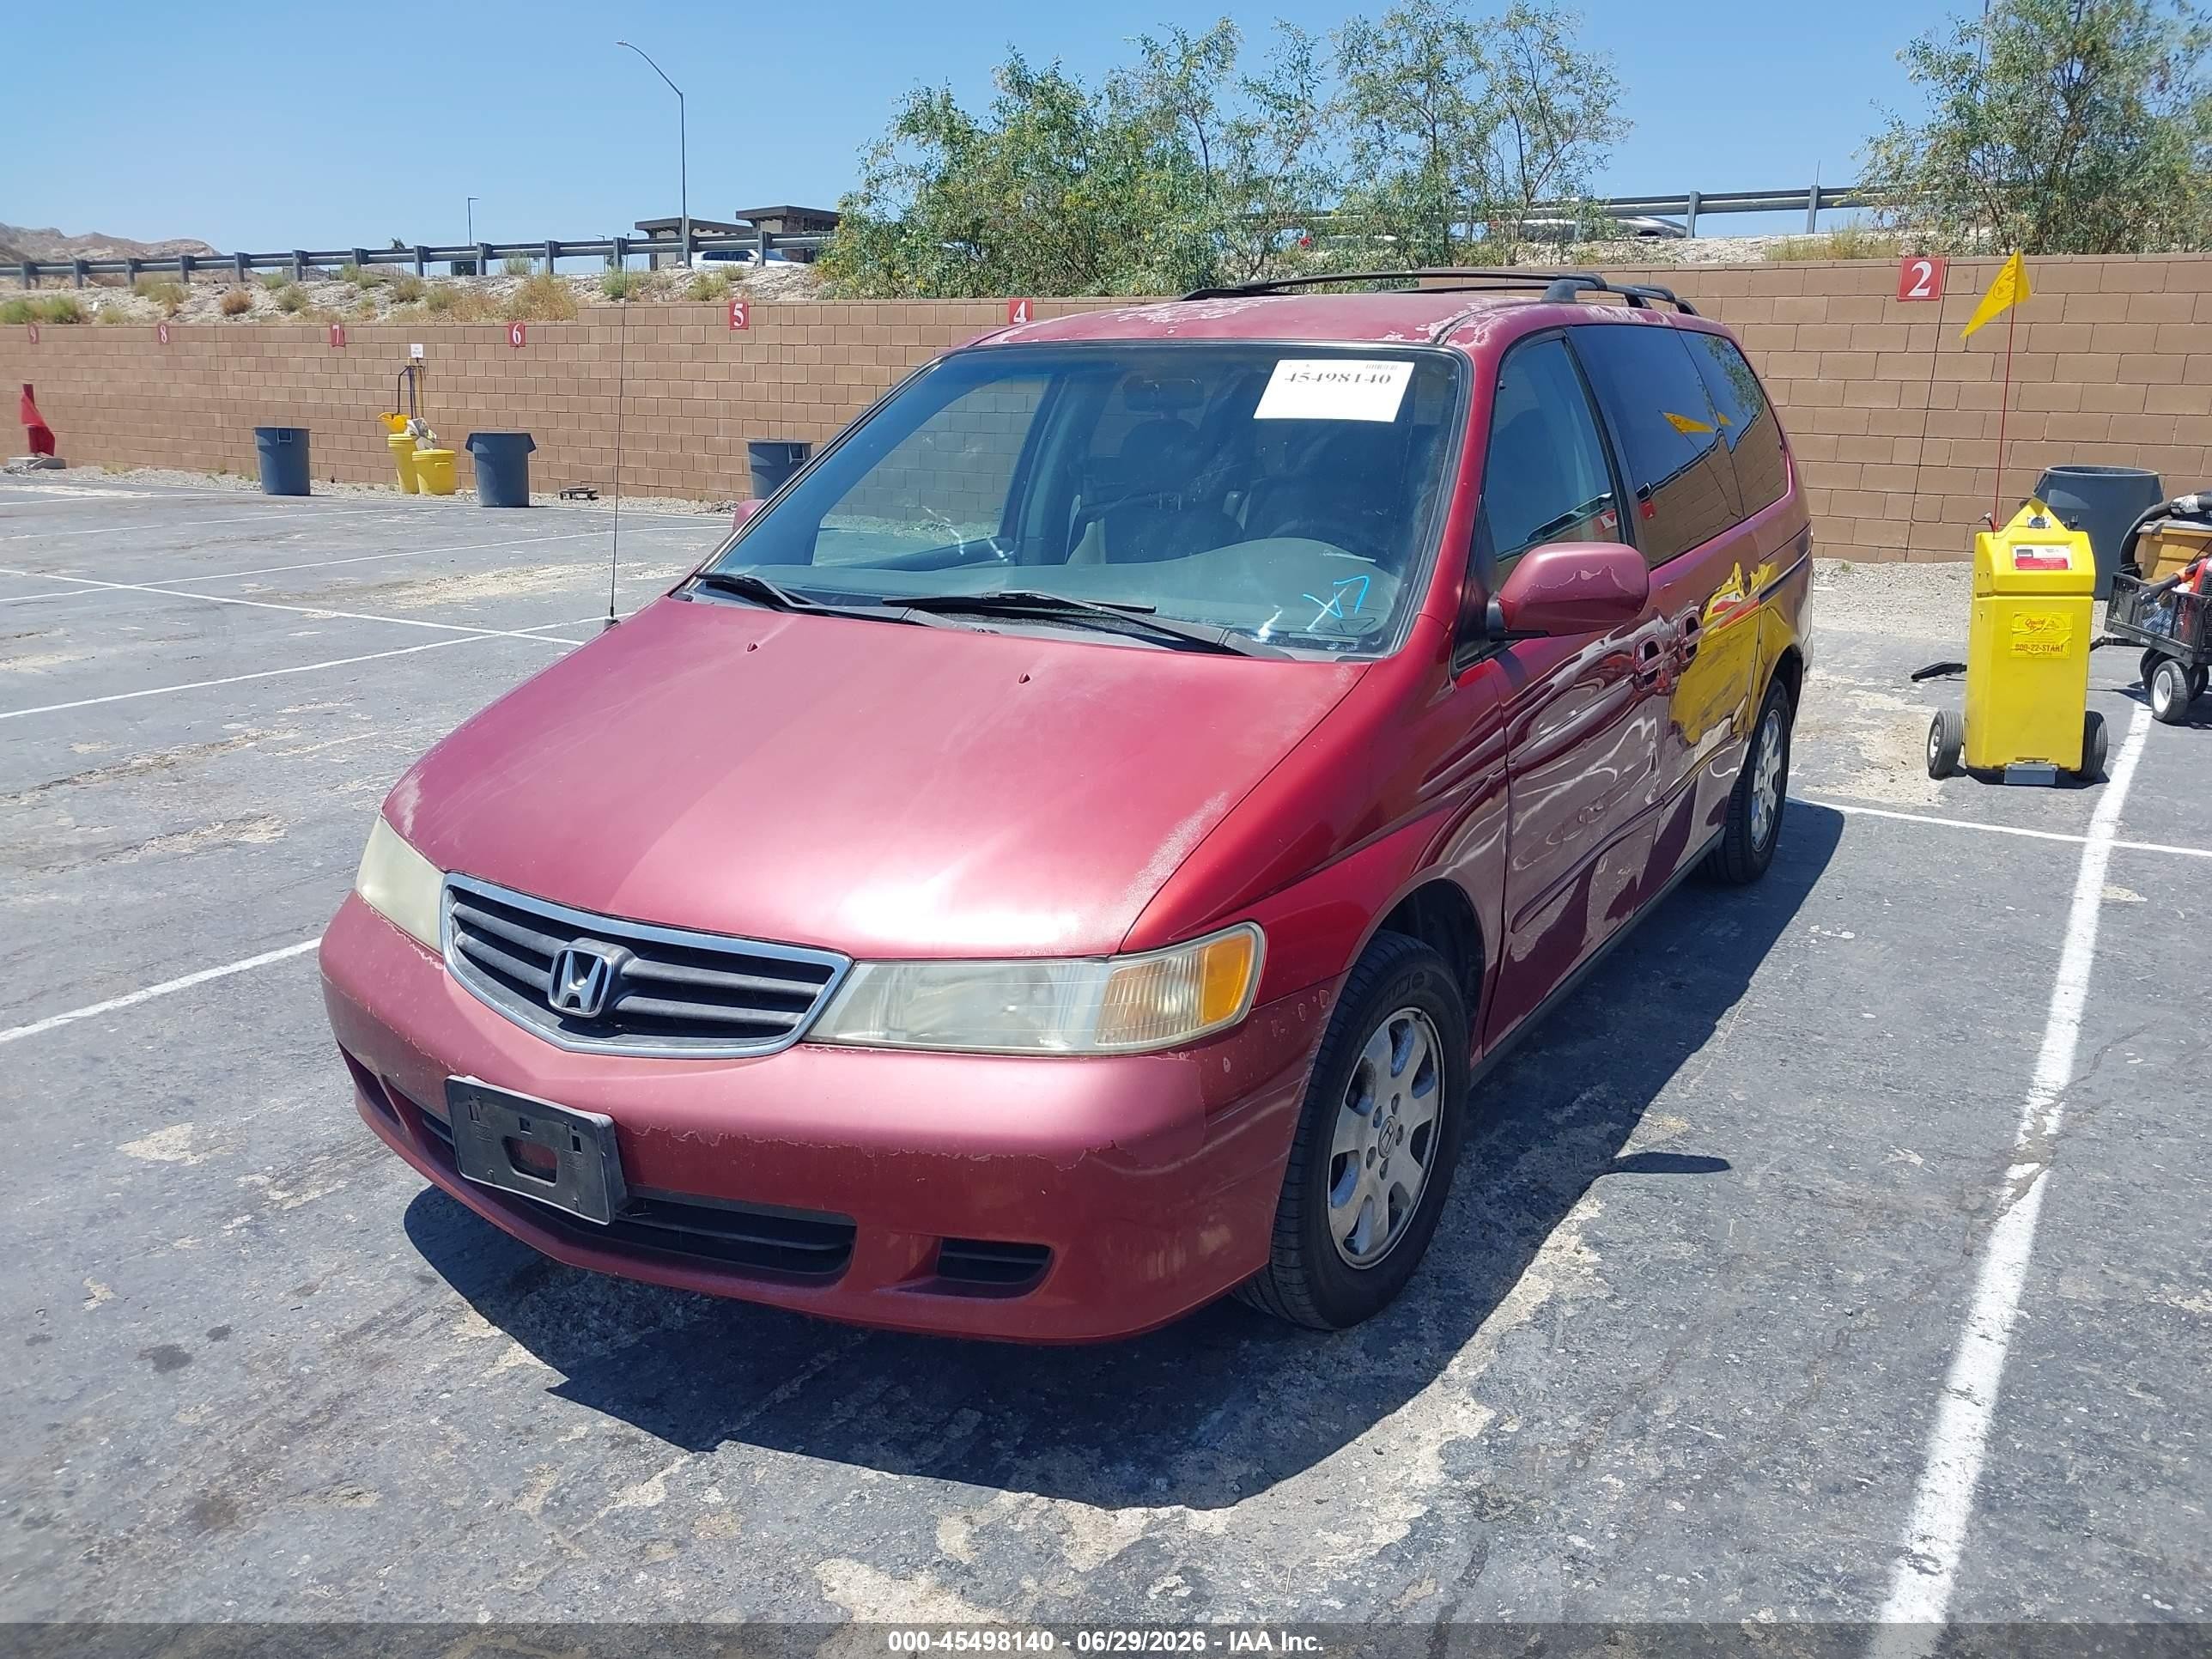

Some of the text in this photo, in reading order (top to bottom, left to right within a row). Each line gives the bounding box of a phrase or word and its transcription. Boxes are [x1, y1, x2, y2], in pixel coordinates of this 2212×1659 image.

[1906, 260, 1932, 297] 2
[732, 302, 744, 327] 5
[1012, 301, 1028, 325] 4
[29, 324, 37, 343] 9
[160, 325, 168, 343] 8
[332, 324, 341, 344] 7
[513, 323, 522, 344] 6
[1285, 371, 1392, 385] 45498140
